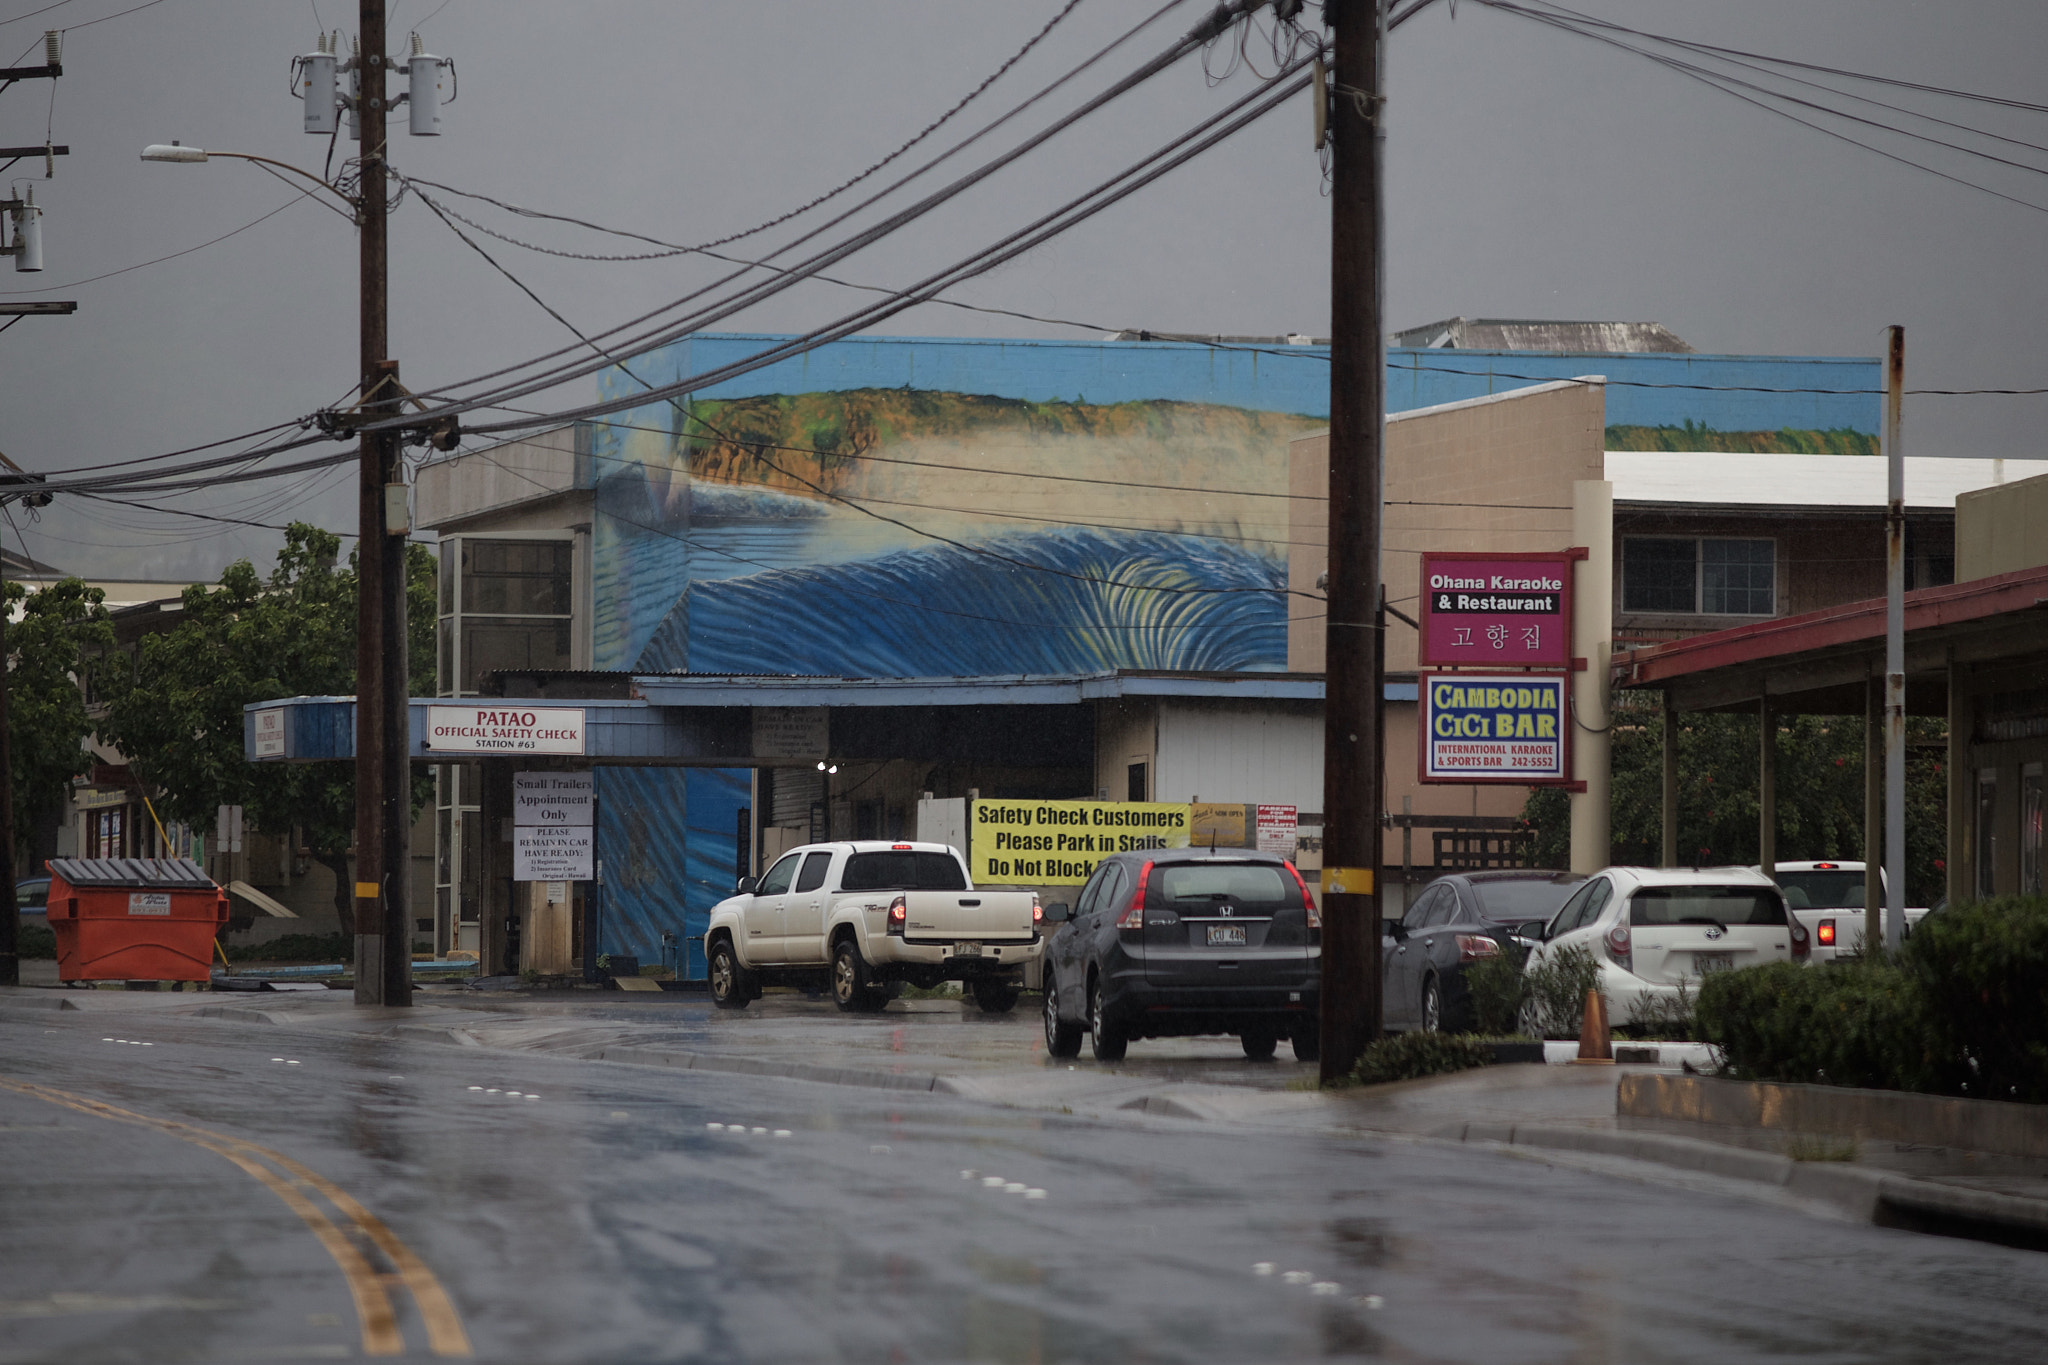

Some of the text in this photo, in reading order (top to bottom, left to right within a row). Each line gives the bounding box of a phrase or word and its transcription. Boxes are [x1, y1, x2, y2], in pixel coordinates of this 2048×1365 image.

[1430, 575, 1562, 590] Ohana Karaoke
[1438, 595, 1552, 611] & Restaurant
[1434, 684, 1557, 709] CAMBODIA
[476, 711, 536, 727] PATAO
[1496, 714, 1557, 738] BAR
[434, 727, 577, 740] OFFICIAL SAFETY CHECK
[475, 739, 536, 749] STATION #63
[1438, 745, 1553, 755] INTERNATIONAL KARAOKE
[1438, 757, 1445, 766] &
[1447, 757, 1481, 766] SPORTS
[1483, 757, 1502, 766] BAR
[516, 779, 592, 789] Small Trailers
[518, 794, 588, 806] Appointment
[541, 809, 567, 821] Only
[978, 805, 1185, 827] Safety Check Customers
[537, 828, 571, 836] PLEASE
[996, 832, 1053, 850] Please
[1057, 834, 1095, 851] Park
[1099, 835, 1114, 852] in
[988, 858, 1093, 878] Do Not Block
[1208, 929, 1245, 941] LCU 448
